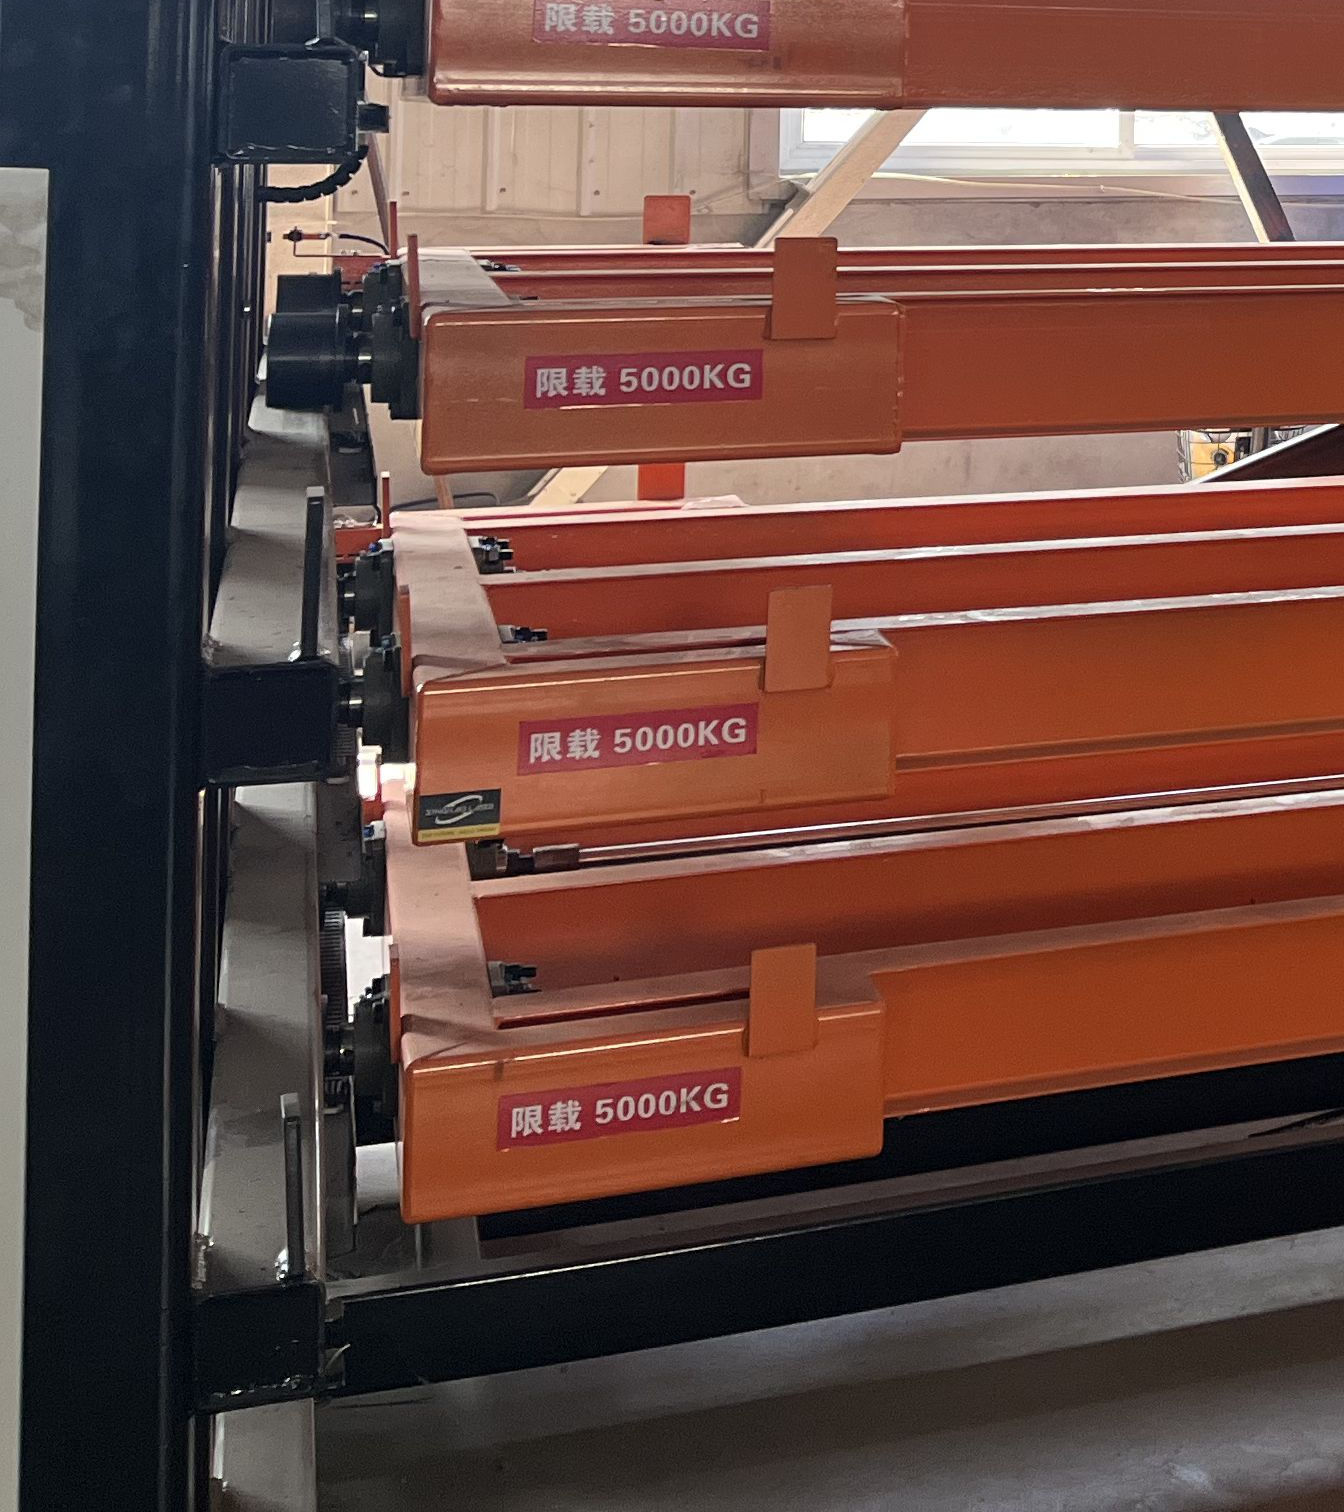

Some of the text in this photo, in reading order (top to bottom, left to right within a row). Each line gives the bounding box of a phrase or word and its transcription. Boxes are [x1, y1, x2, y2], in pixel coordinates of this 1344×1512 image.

[544, 3, 759, 38] 限载 5000KG
[535, 363, 752, 399] 限载 5000KG
[529, 717, 747, 764] 限载 5000KG
[511, 1082, 729, 1138] 限载 5000KG
